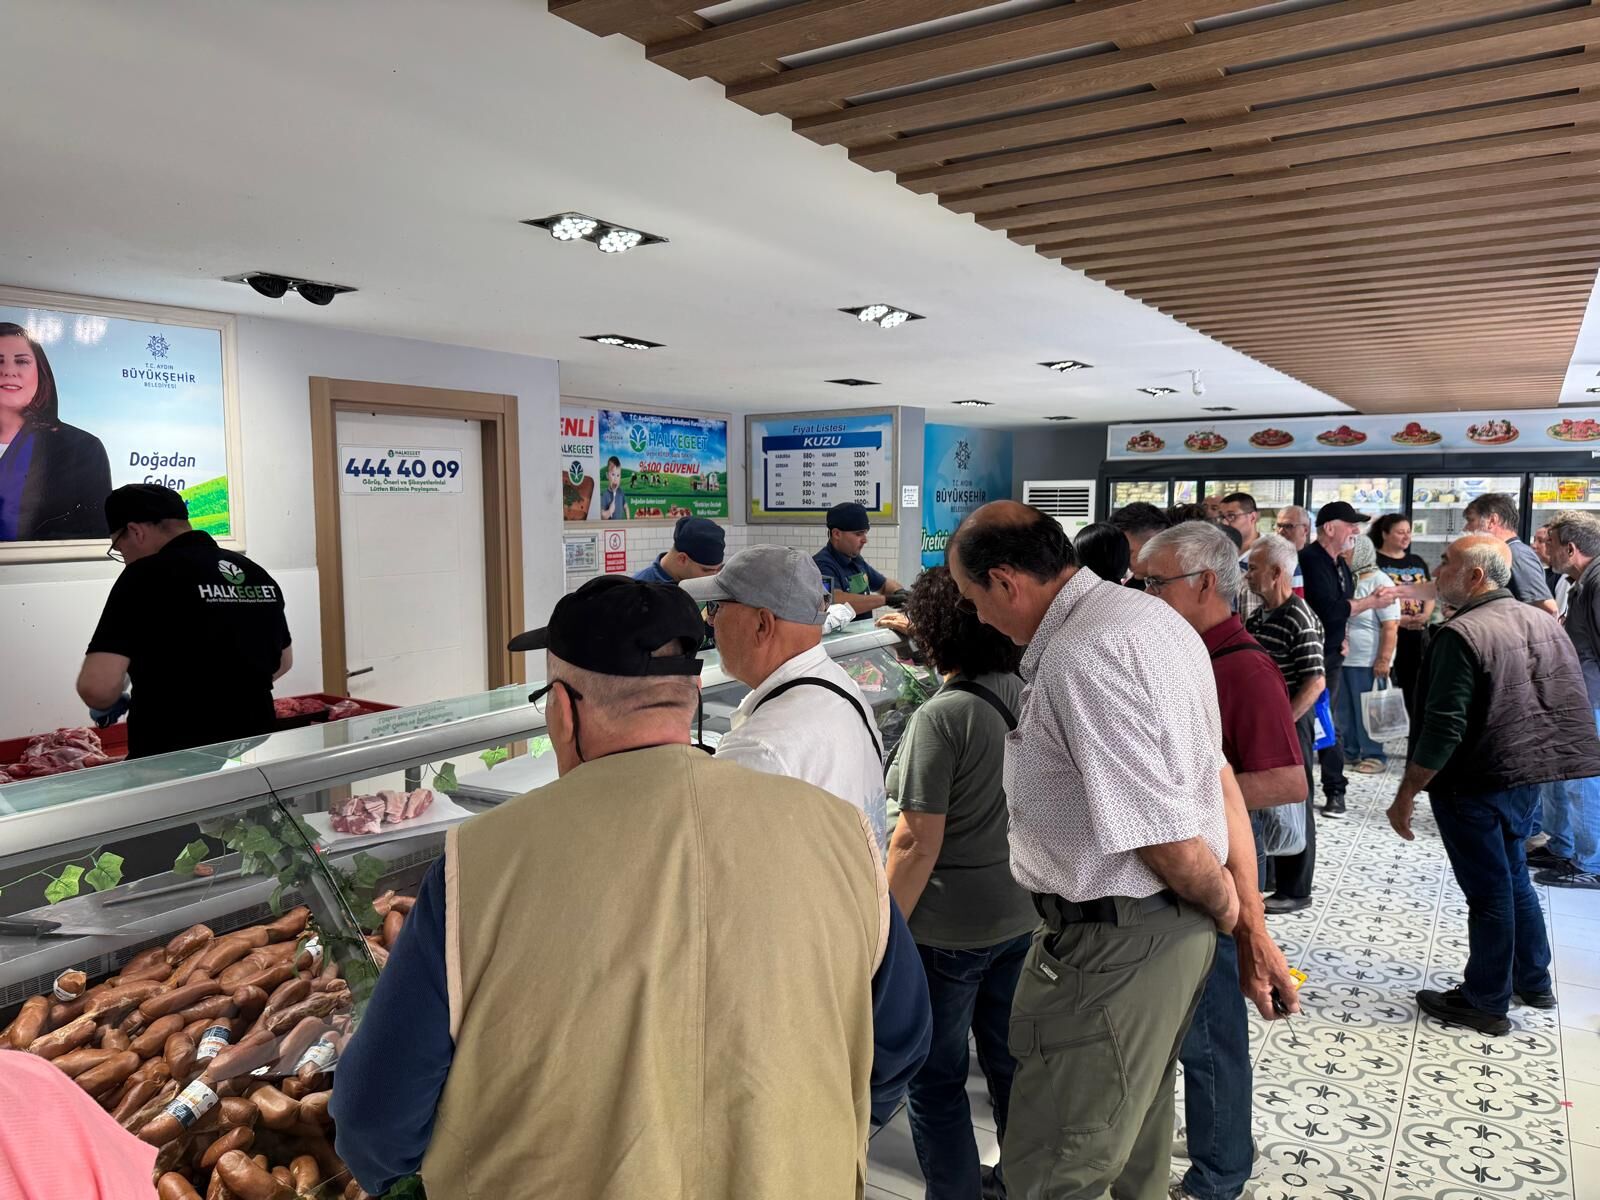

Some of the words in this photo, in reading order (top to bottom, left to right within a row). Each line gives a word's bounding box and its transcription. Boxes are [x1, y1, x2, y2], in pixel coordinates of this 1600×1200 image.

[122, 367, 196, 383] BÜYÜKŞEHİR
[144, 381, 177, 389] BELEDİYESİ
[792, 425, 815, 435] Fiyat
[816, 423, 846, 433] Listesi
[648, 431, 708, 450] HALKEGEET
[803, 436, 842, 447] KUZU
[129, 451, 196, 470] Doğadan
[345, 457, 392, 477] 444
[397, 459, 427, 478] 40
[432, 460, 460, 478] 09
[639, 461, 662, 474] %100
[663, 460, 700, 475] GÜVENLİ
[362, 478, 382, 486] Görüş,
[383, 477, 400, 485] Öneri
[936, 487, 987, 505] BÜYÜKŞEHİR
[198, 584, 277, 598] HALKEGEET
